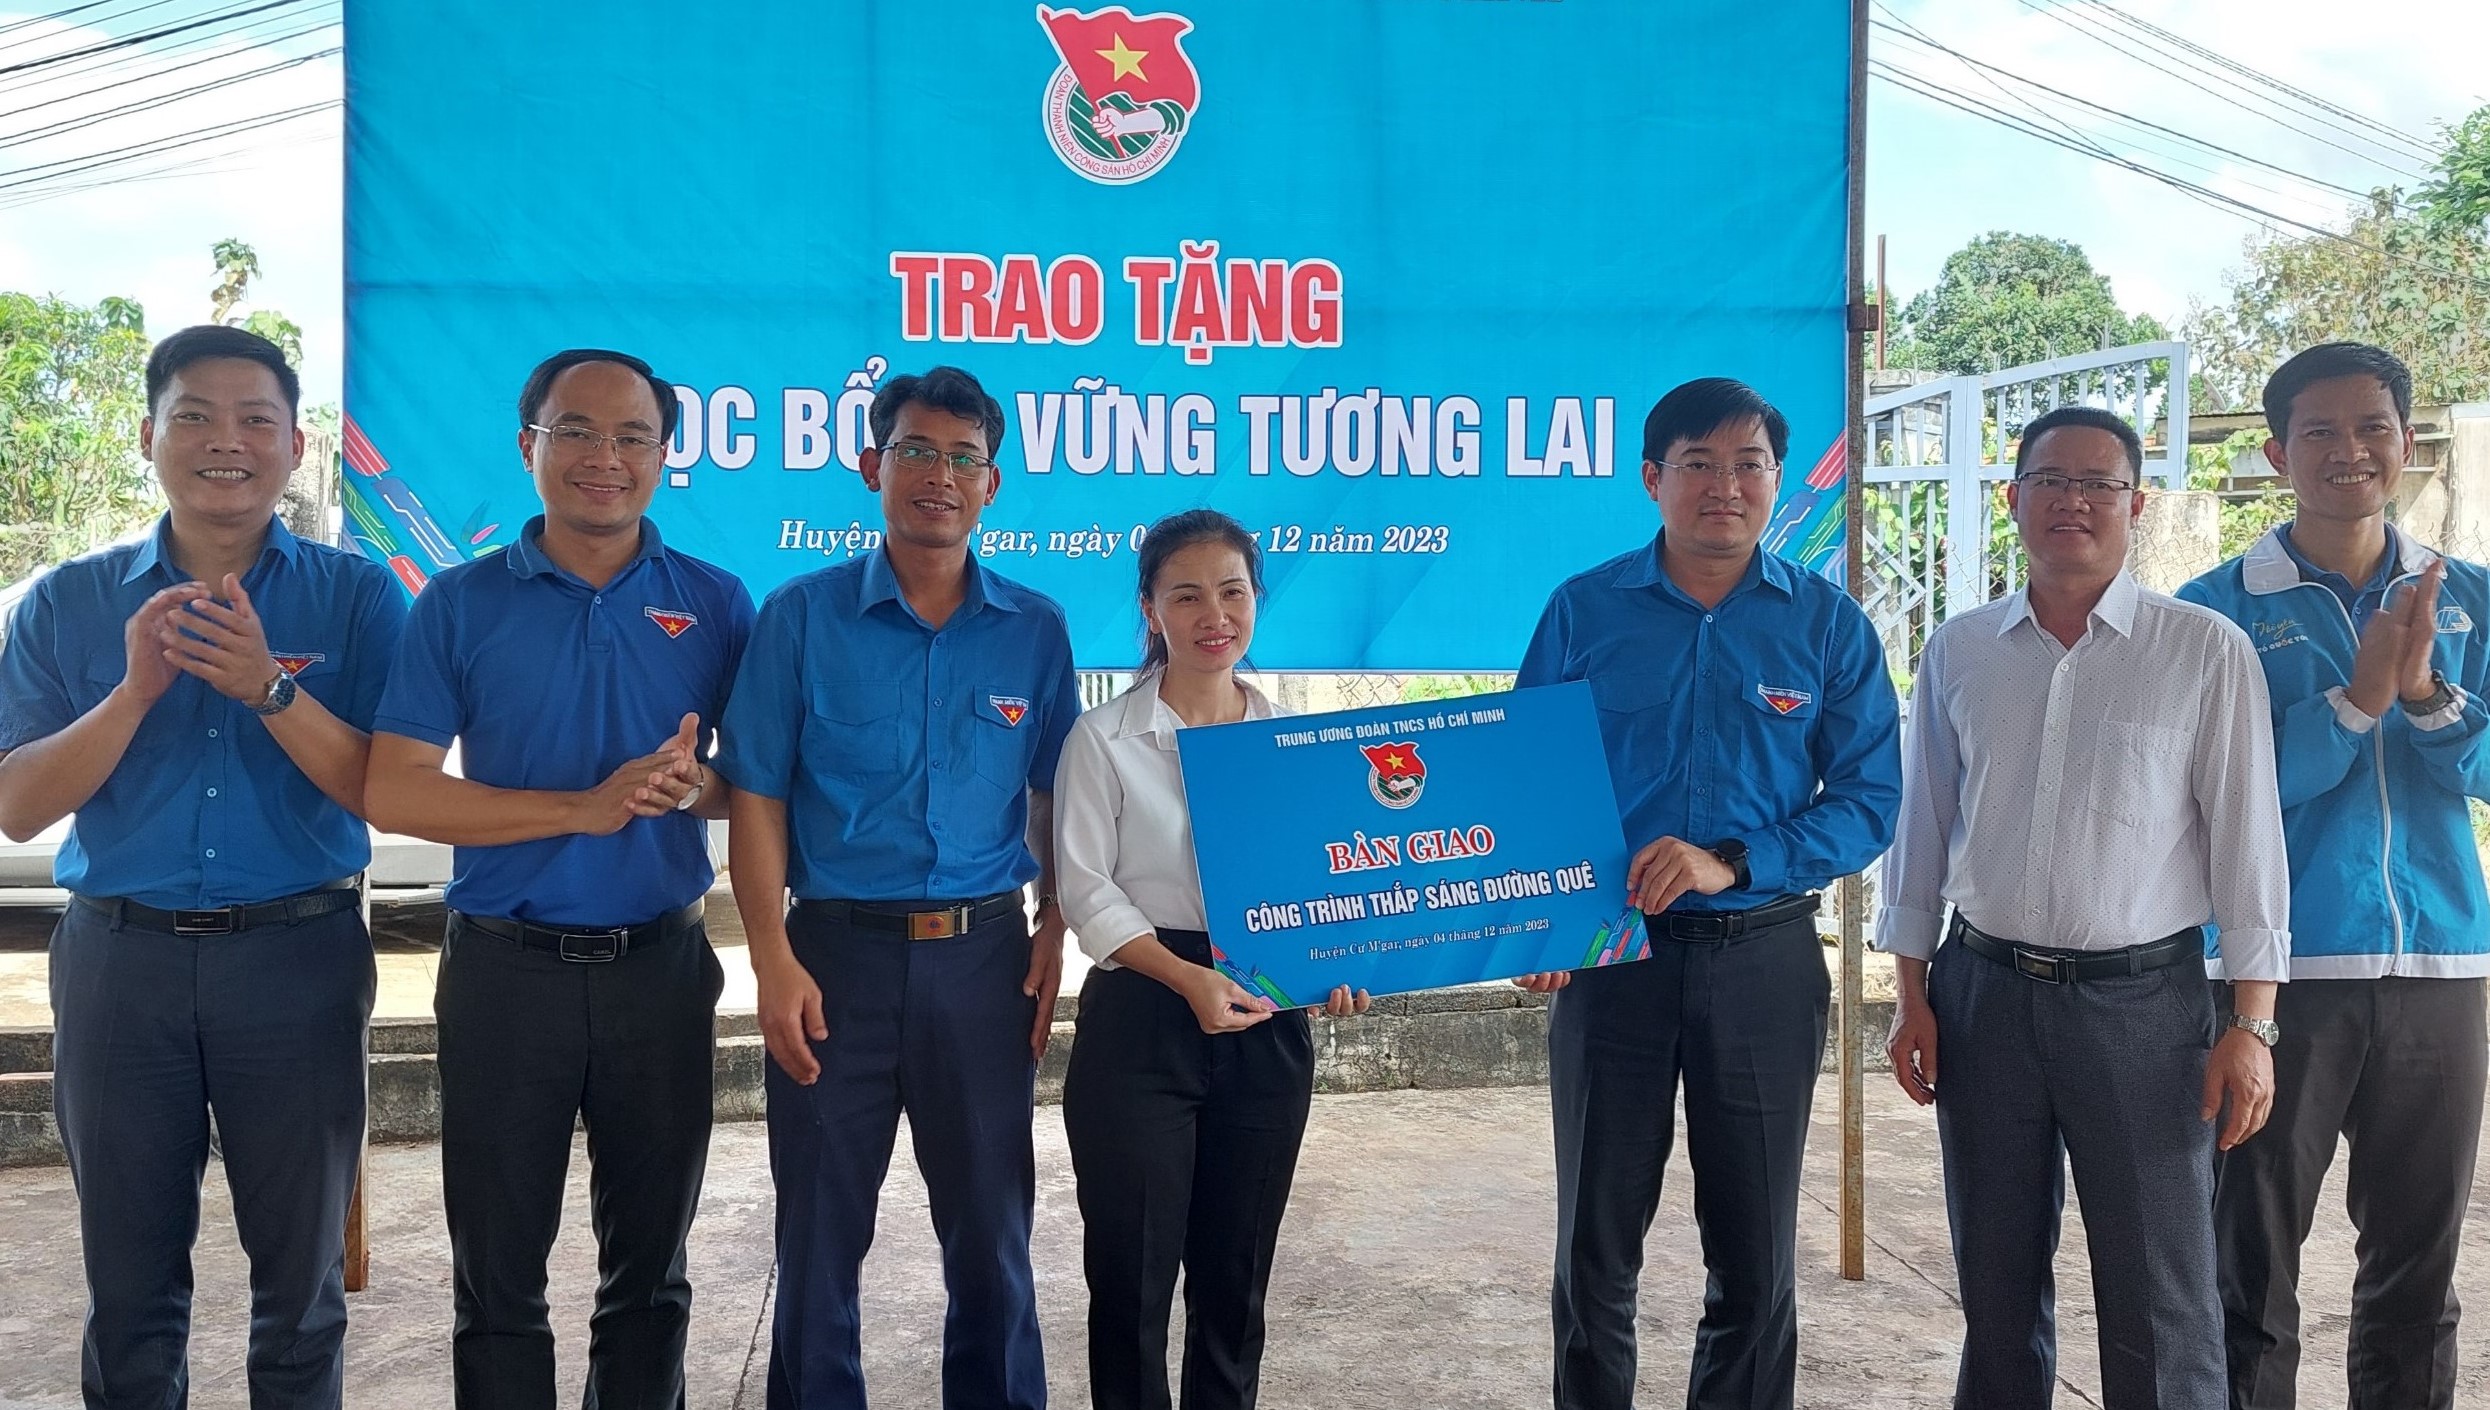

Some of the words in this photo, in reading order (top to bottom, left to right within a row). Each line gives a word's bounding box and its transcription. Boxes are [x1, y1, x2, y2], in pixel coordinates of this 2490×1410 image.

[1151, 137, 1171, 159] MINH
[890, 251, 1104, 346] TRAO
[1123, 240, 1343, 365] TẶNG
[664, 384, 757, 488] ỌC
[783, 356, 888, 471] BỔ
[1016, 377, 1217, 476] VỮNG
[1240, 387, 1482, 477] TƯƠNG
[1505, 396, 1615, 478] LAI
[777, 519, 881, 557] Huyện
[967, 524, 1039, 558] 'gar,
[1048, 524, 1124, 558] ngày
[1267, 525, 1303, 553] 12
[1308, 526, 1374, 553] năm
[1380, 525, 1450, 553] 2023
[1274, 731, 1316, 748] TRUNG
[1319, 726, 1353, 743] ƯƠNG
[1356, 721, 1390, 738] ĐOÀN
[1393, 718, 1425, 735] TNCS
[1447, 713, 1469, 728] CHÍ
[1472, 708, 1505, 724] MINH
[1325, 831, 1401, 875] BÀN
[1406, 824, 1496, 864] GIAO
[1246, 901, 1302, 934] CÔNG
[1304, 894, 1366, 926] TRÌNH
[1368, 881, 1420, 918] THẮP
[1425, 879, 1480, 910] SÁNG
[1483, 870, 1551, 903] ĐƯỜNG
[1555, 861, 1596, 894] QUÊ
[1310, 947, 1346, 961] Huyện
[1350, 943, 1365, 955] Cư
[1404, 936, 1430, 949] ngày
[1433, 932, 1446, 944] 04
[1449, 928, 1481, 943] tháng
[1483, 925, 1496, 937] 12
[1499, 922, 1522, 935] năm
[1524, 918, 1550, 932] 2023
